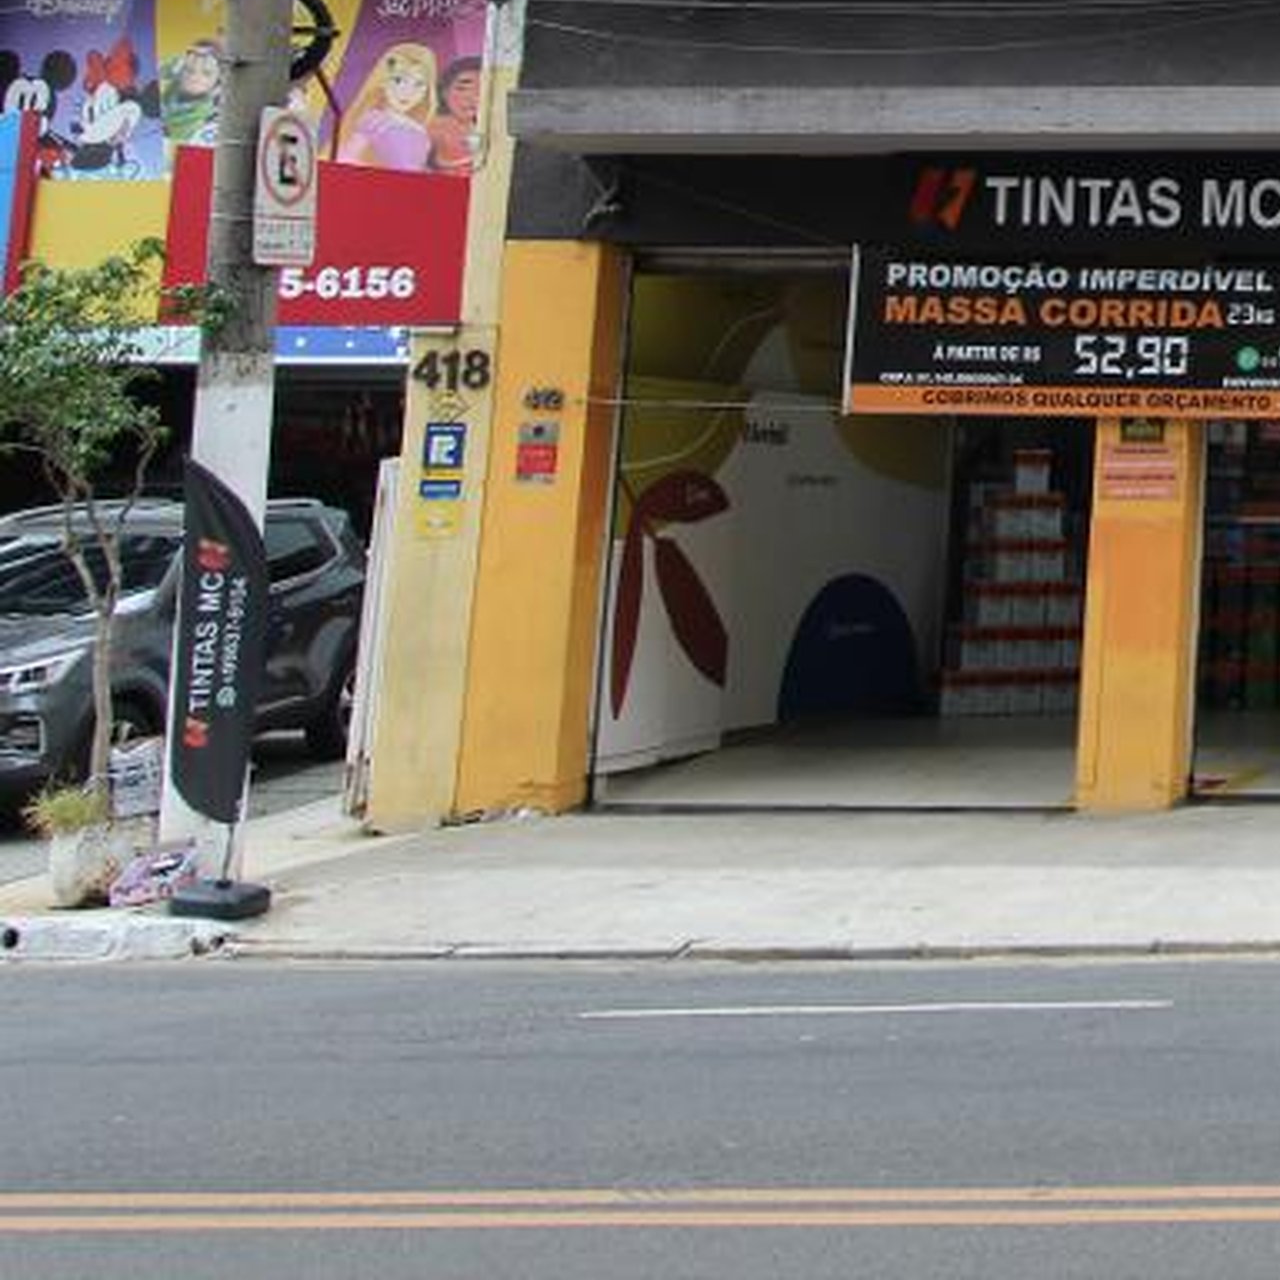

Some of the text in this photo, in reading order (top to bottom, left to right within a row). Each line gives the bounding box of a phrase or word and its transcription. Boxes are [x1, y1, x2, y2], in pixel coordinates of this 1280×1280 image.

[985, 176, 1182, 228] TINTAS
[278, 266, 416, 300] 5-6156
[886, 262, 1275, 295] PROMOÇÃO IMPERDÍVEL
[883, 295, 1028, 325] MASSA
[1038, 297, 1226, 329] CORRIDA
[413, 350, 490, 391] 418
[1074, 334, 1189, 380] 52,90
[922, 389, 1029, 406] COBRIMOS
[1032, 390, 1141, 408] QUALQUER
[1145, 393, 1271, 412] ORÇAMENTO
[189, 572, 225, 713] TINTAS MC
